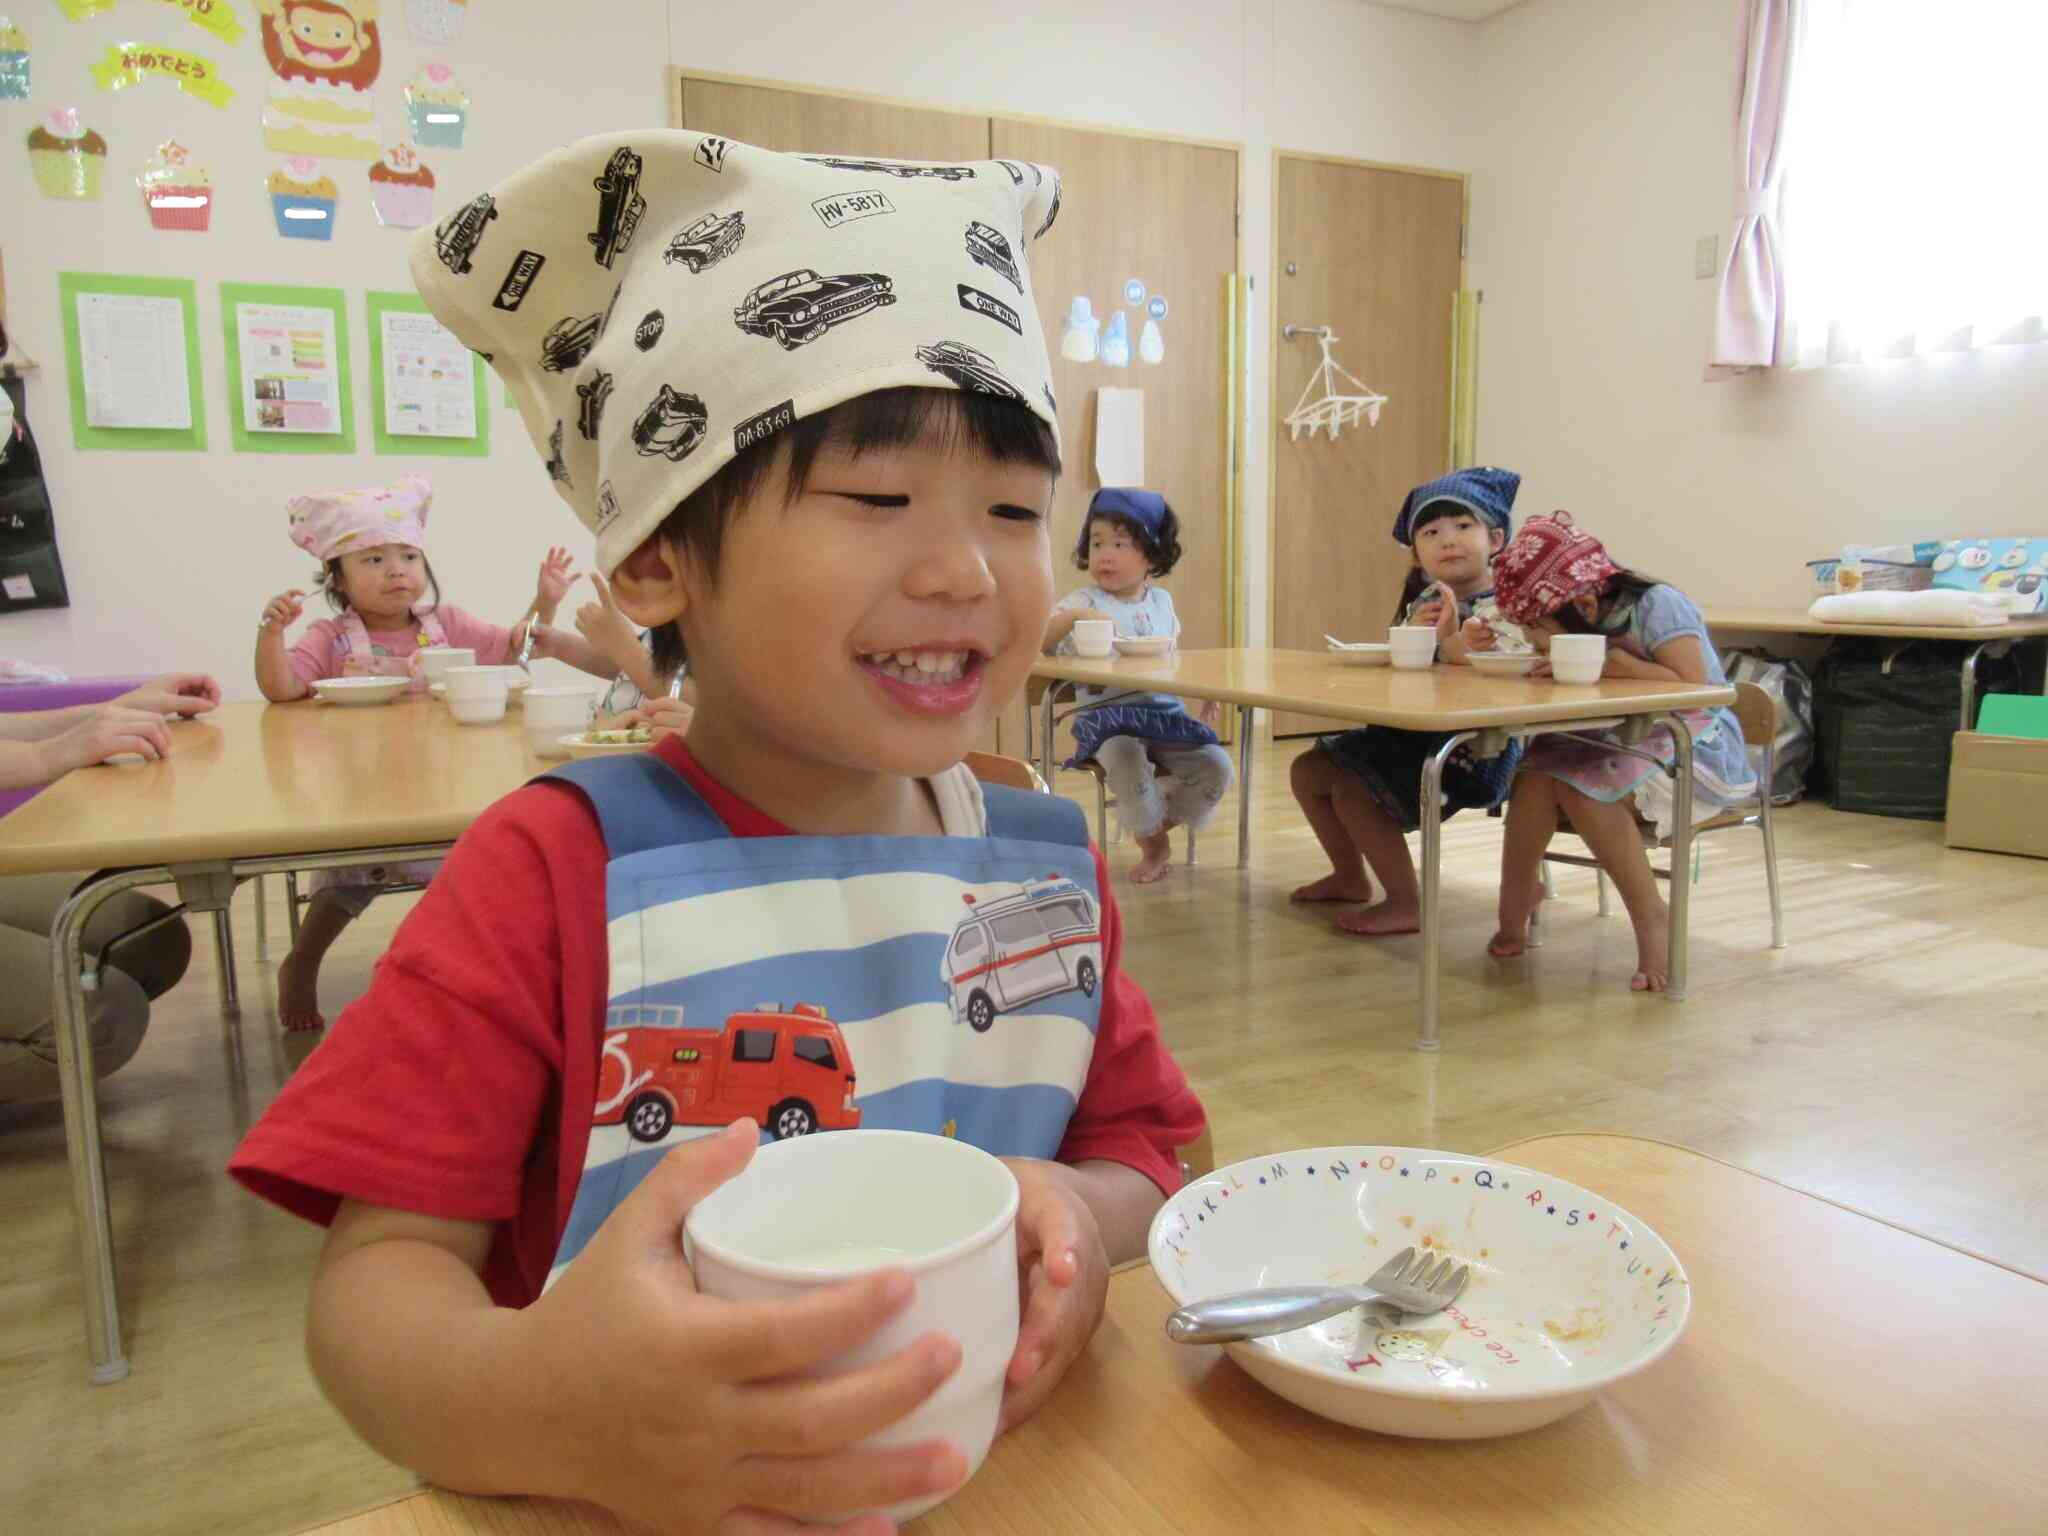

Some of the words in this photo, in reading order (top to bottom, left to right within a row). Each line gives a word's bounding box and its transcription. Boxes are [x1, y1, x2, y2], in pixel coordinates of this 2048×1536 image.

[121, 53, 206, 79] おめでとう
[820, 194, 885, 221] HV-5817
[516, 255, 538, 278] WAY
[977, 296, 998, 314] ONE
[999, 307, 1020, 329] WAY
[635, 318, 663, 342] STOP
[1330, 1159, 1350, 1181] N
[1424, 1168, 1437, 1182] P
[1474, 1170, 1493, 1189] Q
[1526, 1189, 1542, 1207] R
[1566, 1209, 1580, 1226] S
